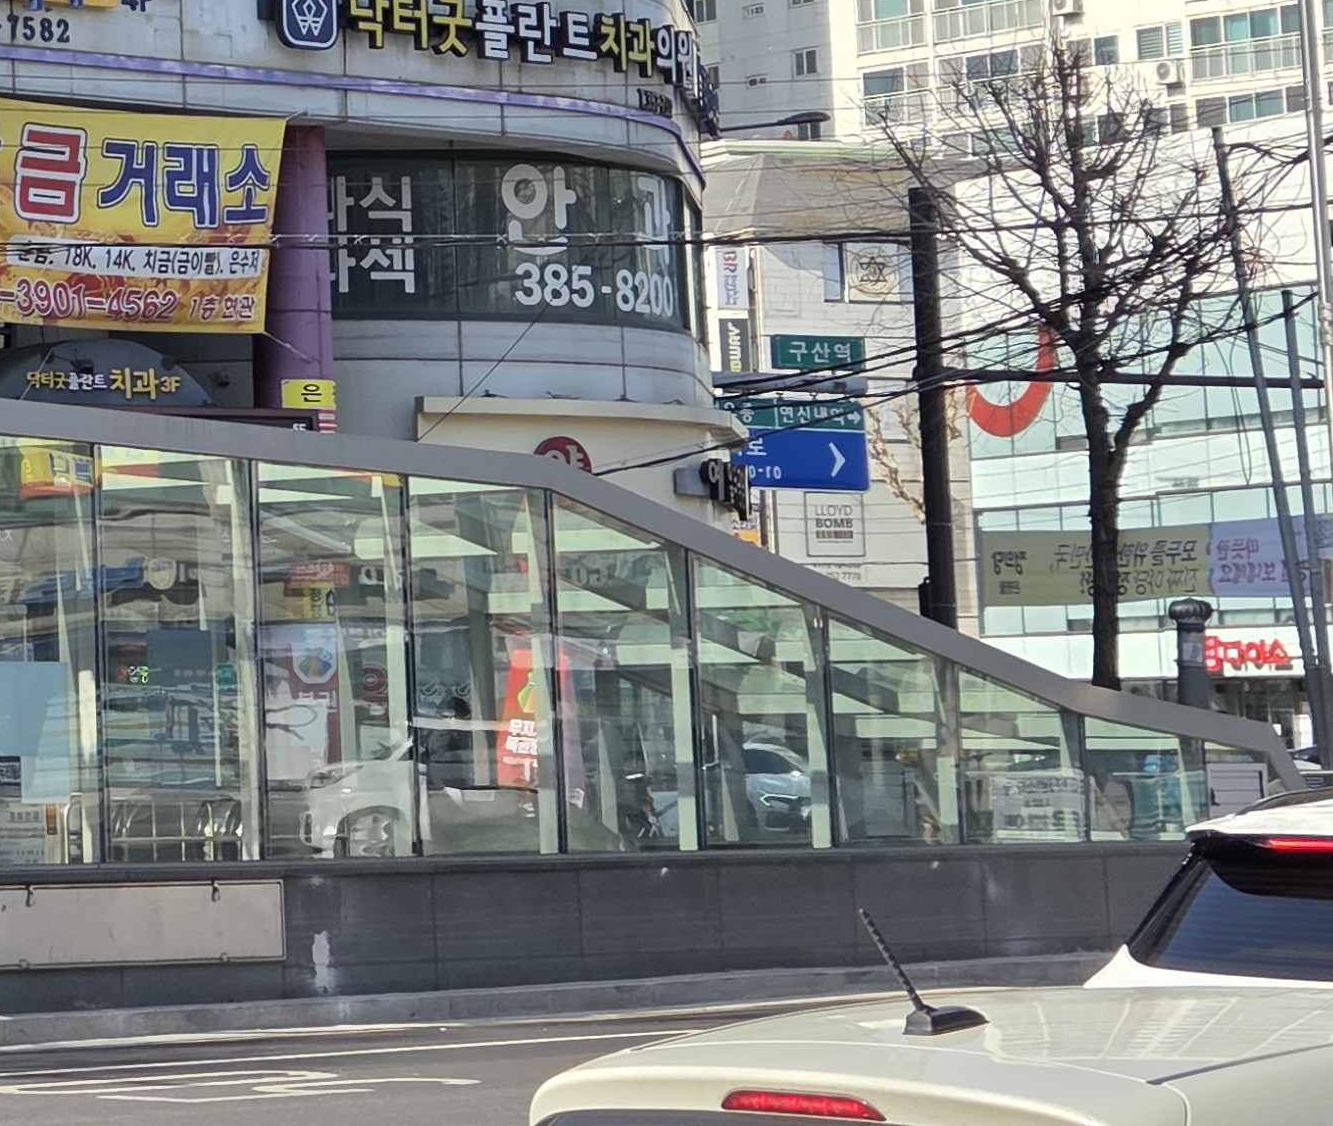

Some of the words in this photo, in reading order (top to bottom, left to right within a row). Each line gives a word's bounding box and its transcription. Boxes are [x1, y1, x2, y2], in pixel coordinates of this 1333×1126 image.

[228, 250, 261, 274] 은수저
[514, 262, 674, 318] 385-8200
[788, 341, 852, 365] 구산역
[109, 368, 158, 400] 치과
[161, 379, 182, 394] 3F
[814, 505, 853, 516] LLOYD
[815, 518, 854, 529] BOMB
